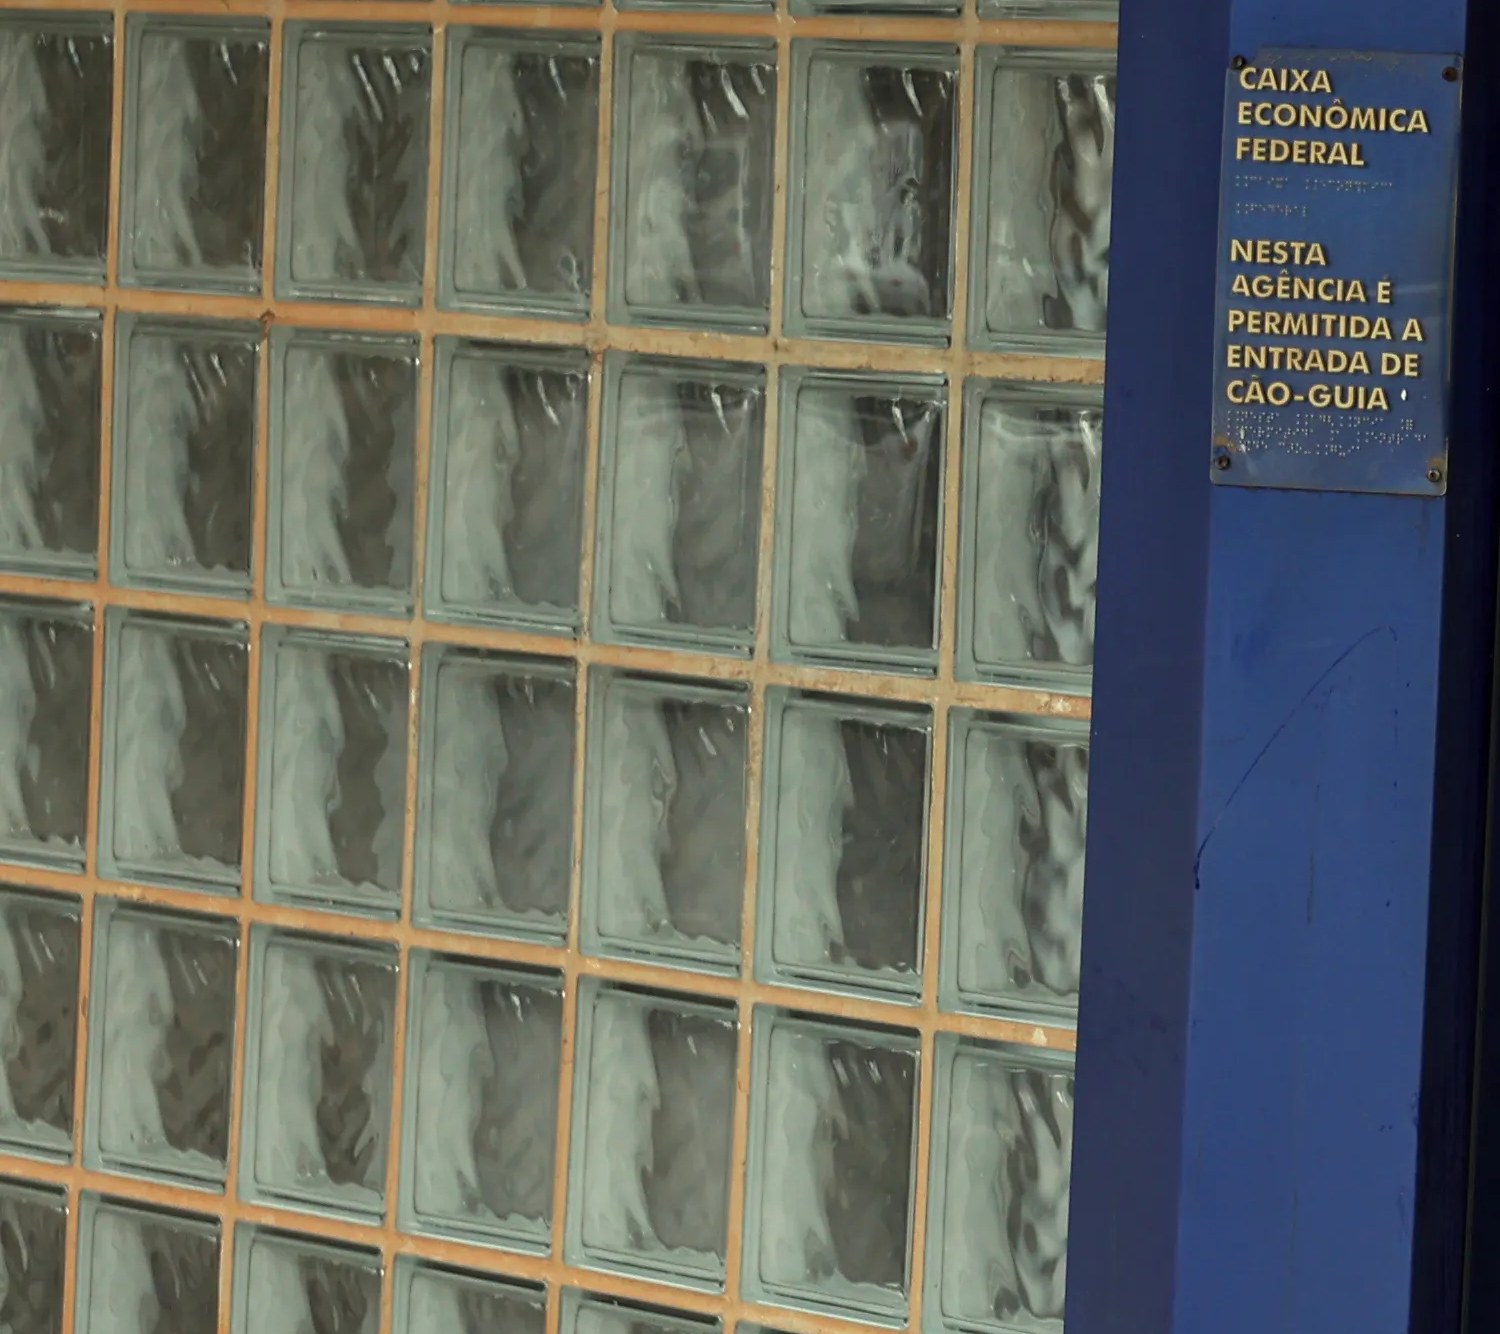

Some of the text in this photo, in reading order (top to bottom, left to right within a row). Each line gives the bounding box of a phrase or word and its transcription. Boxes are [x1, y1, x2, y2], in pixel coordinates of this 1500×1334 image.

[1240, 66, 1332, 93] CAIXA
[1237, 98, 1429, 133] ECONÔMICA
[1236, 137, 1365, 166] FEDERAL
[1231, 239, 1327, 265] NESTA
[1232, 269, 1392, 303] AGÊNCIA É
[1228, 310, 1423, 342] PERMITIDA A
[1226, 345, 1419, 377] ENTRADA DE
[1226, 375, 1389, 411] CÃO-GUIA
